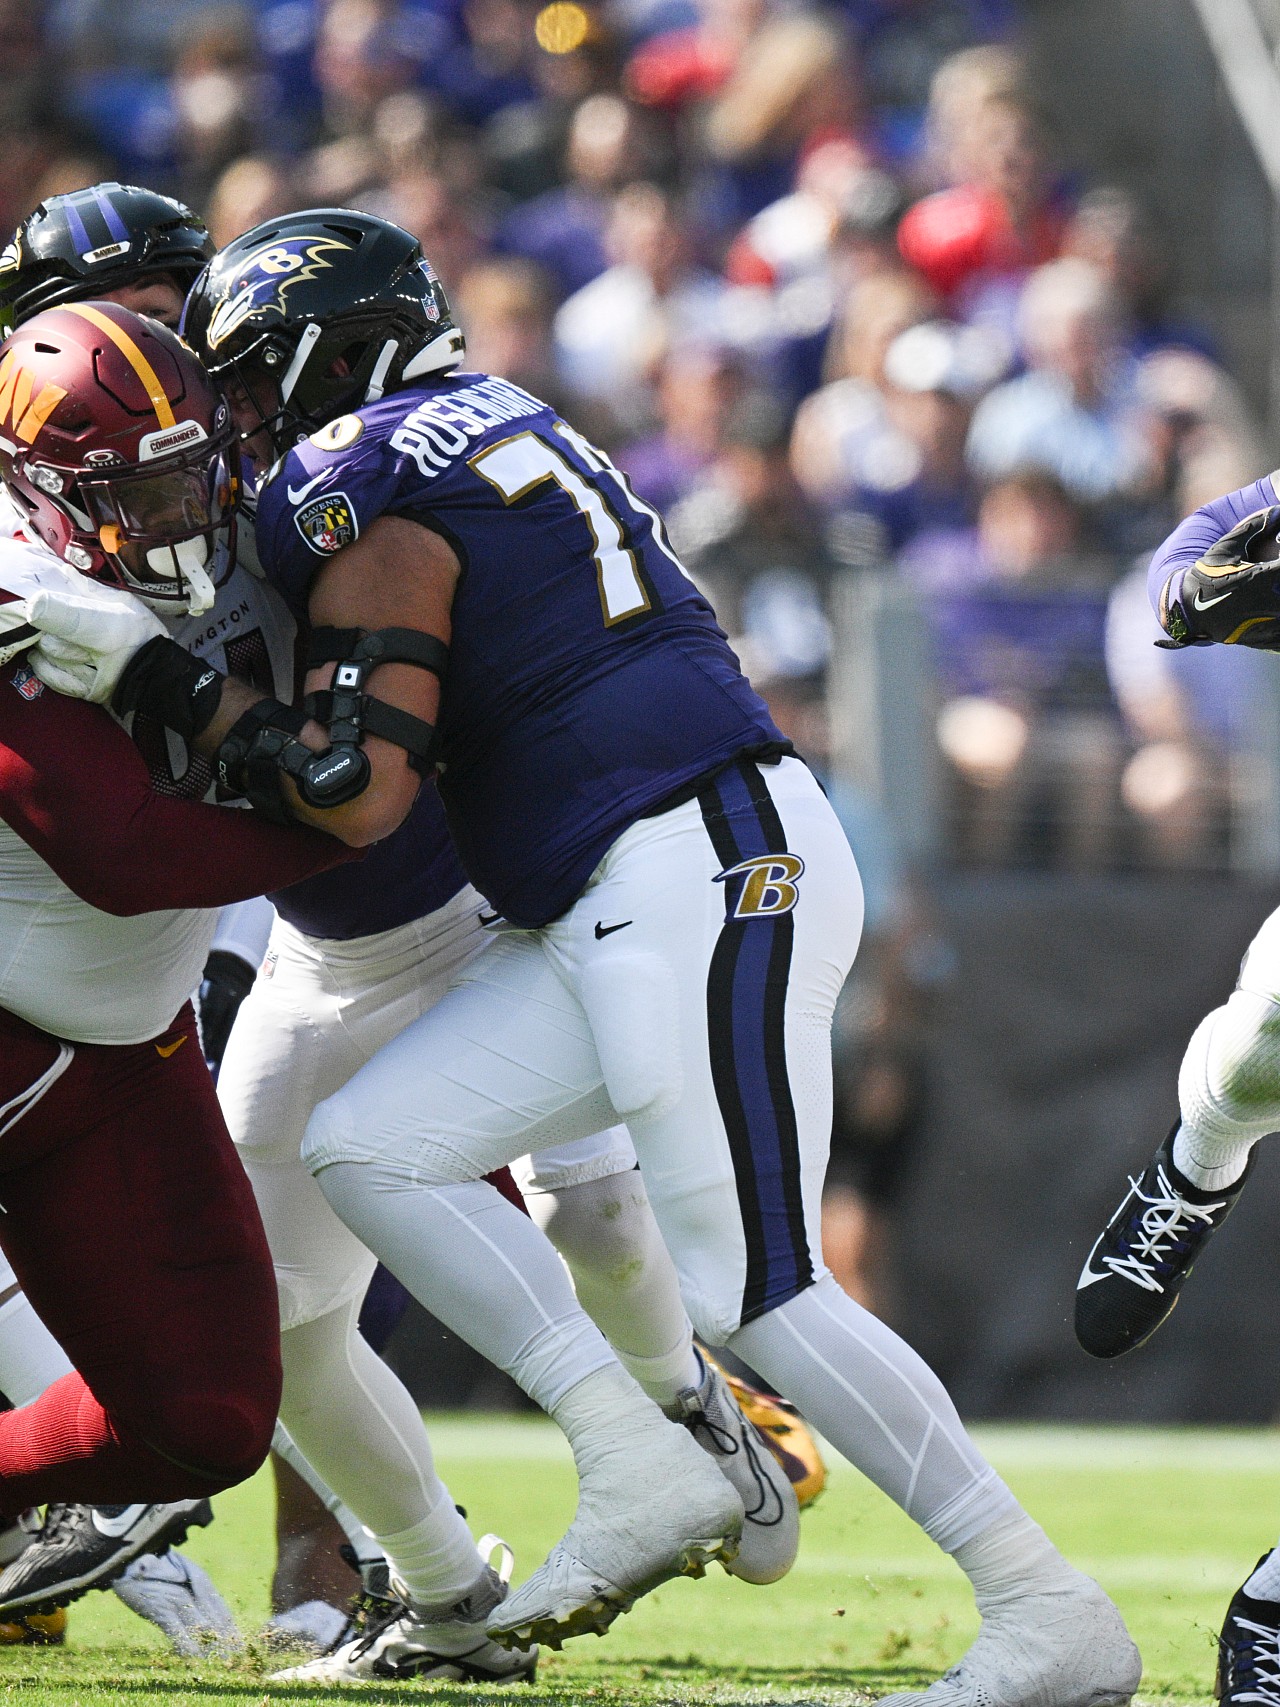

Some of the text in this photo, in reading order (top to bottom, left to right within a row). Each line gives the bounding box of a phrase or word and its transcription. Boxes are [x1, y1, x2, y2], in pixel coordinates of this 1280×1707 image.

[93, 245, 122, 260] RAVENS
[150, 427, 200, 452] COMMANDERS
[85, 460, 120, 468] OAKLEY
[301, 498, 341, 521] RAVENS
[188, 601, 250, 652] INGTON
[313, 758, 350, 784] DONJOY
[710, 852, 805, 923] B
